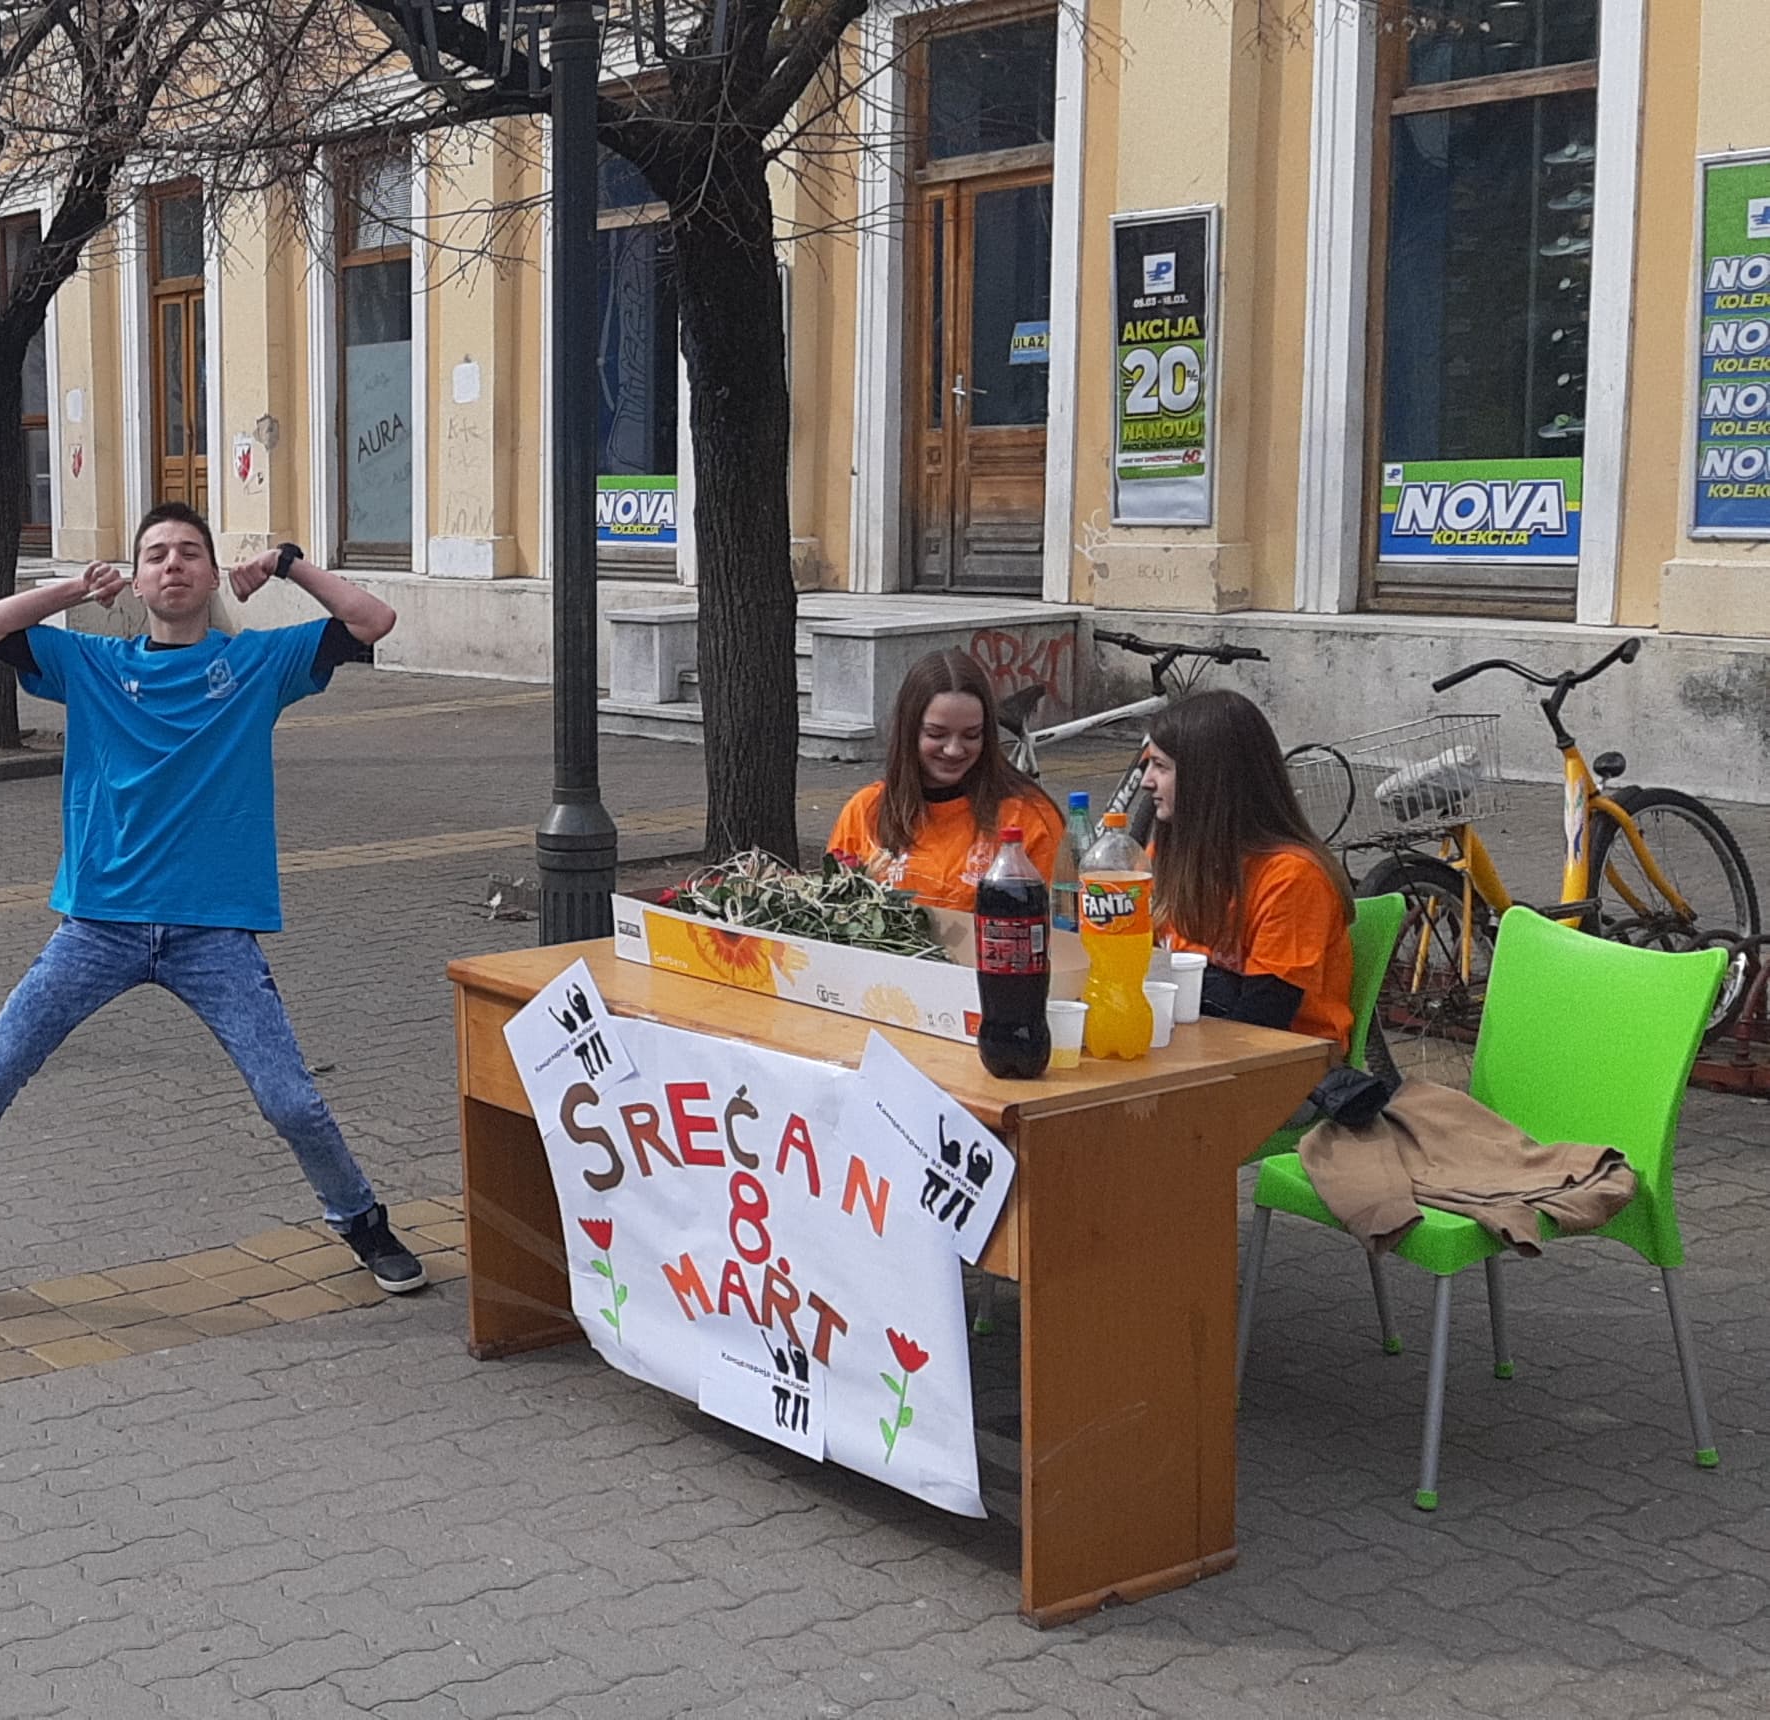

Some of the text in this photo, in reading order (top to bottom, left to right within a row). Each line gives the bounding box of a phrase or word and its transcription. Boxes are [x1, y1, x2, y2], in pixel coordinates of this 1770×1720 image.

[1705, 255, 1770, 292] NO
[1714, 293, 1770, 310] KOLEK
[1013, 336, 1045, 349] ULAZ
[1122, 316, 1200, 342] AKCIJA
[1703, 317, 1770, 356] NO
[1712, 356, 1770, 374] KOLEK
[1701, 381, 1770, 418] NO
[357, 412, 405, 464] AURA
[1124, 420, 1201, 440] NA NOVU
[1698, 446, 1770, 481] NO
[596, 489, 678, 527] NOVA
[1393, 480, 1567, 535] NOVA
[1431, 530, 1529, 545] KOLEKCIJA
[1082, 893, 1135, 916] FANTA
[560, 1082, 891, 1237] SREĆAN
[875, 1101, 981, 1199] Канцеларија за младе
[661, 1252, 848, 1365] MART
